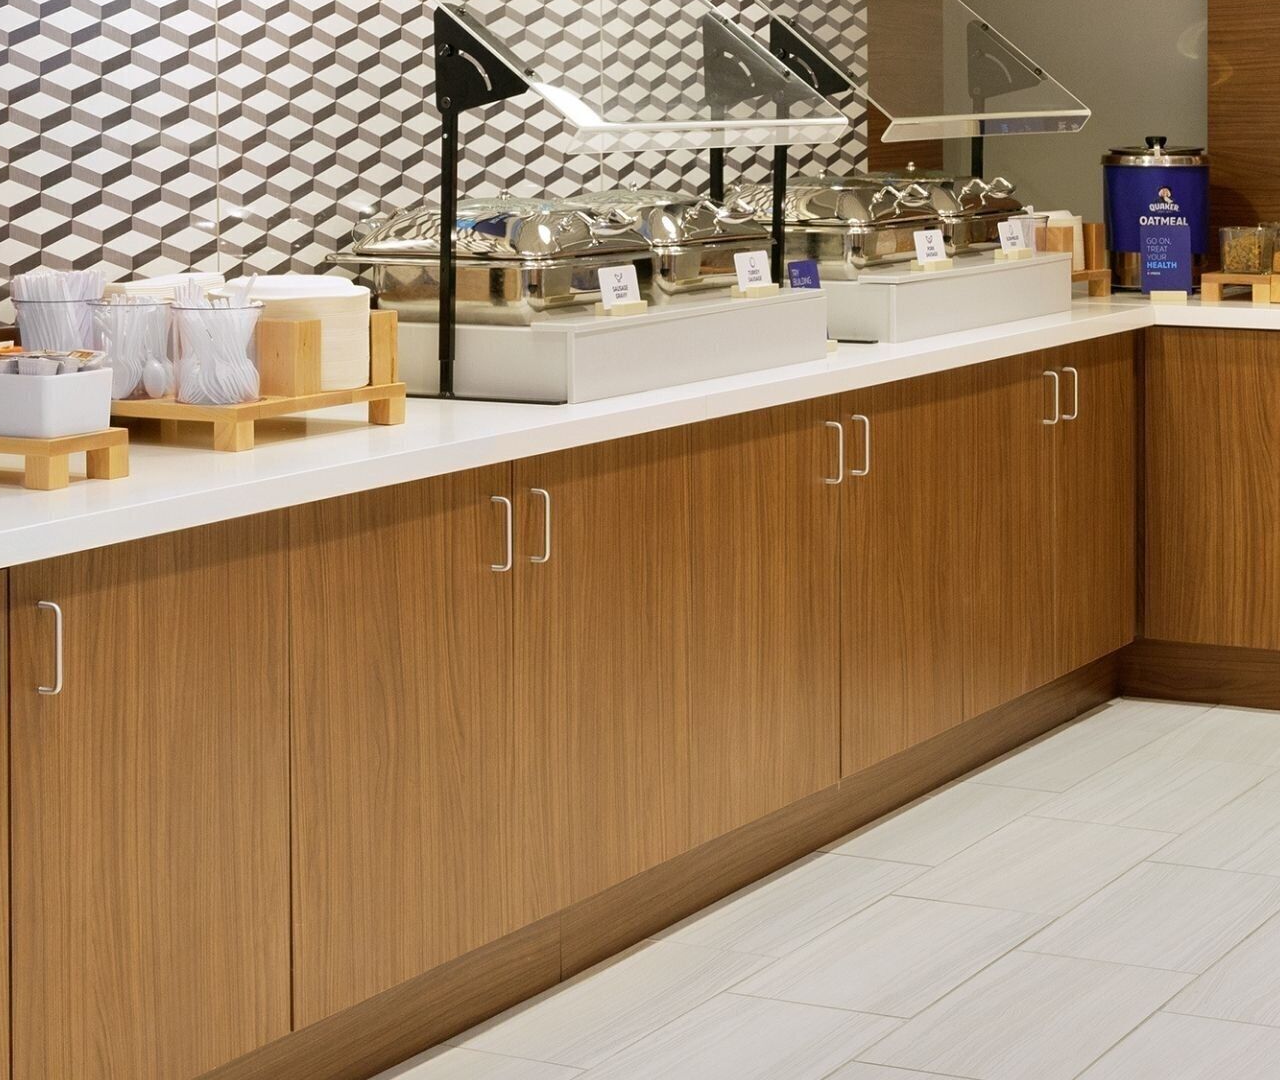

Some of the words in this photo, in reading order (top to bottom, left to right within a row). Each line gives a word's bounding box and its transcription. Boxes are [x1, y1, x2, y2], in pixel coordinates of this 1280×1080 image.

[1149, 202, 1180, 212] QUAKER
[1139, 216, 1189, 226] OATMEAL
[1146, 237, 1158, 245] GO
[1146, 245, 1168, 253] TREAT
[1146, 253, 1167, 261] YOUR
[1146, 261, 1178, 269] HEALTH
